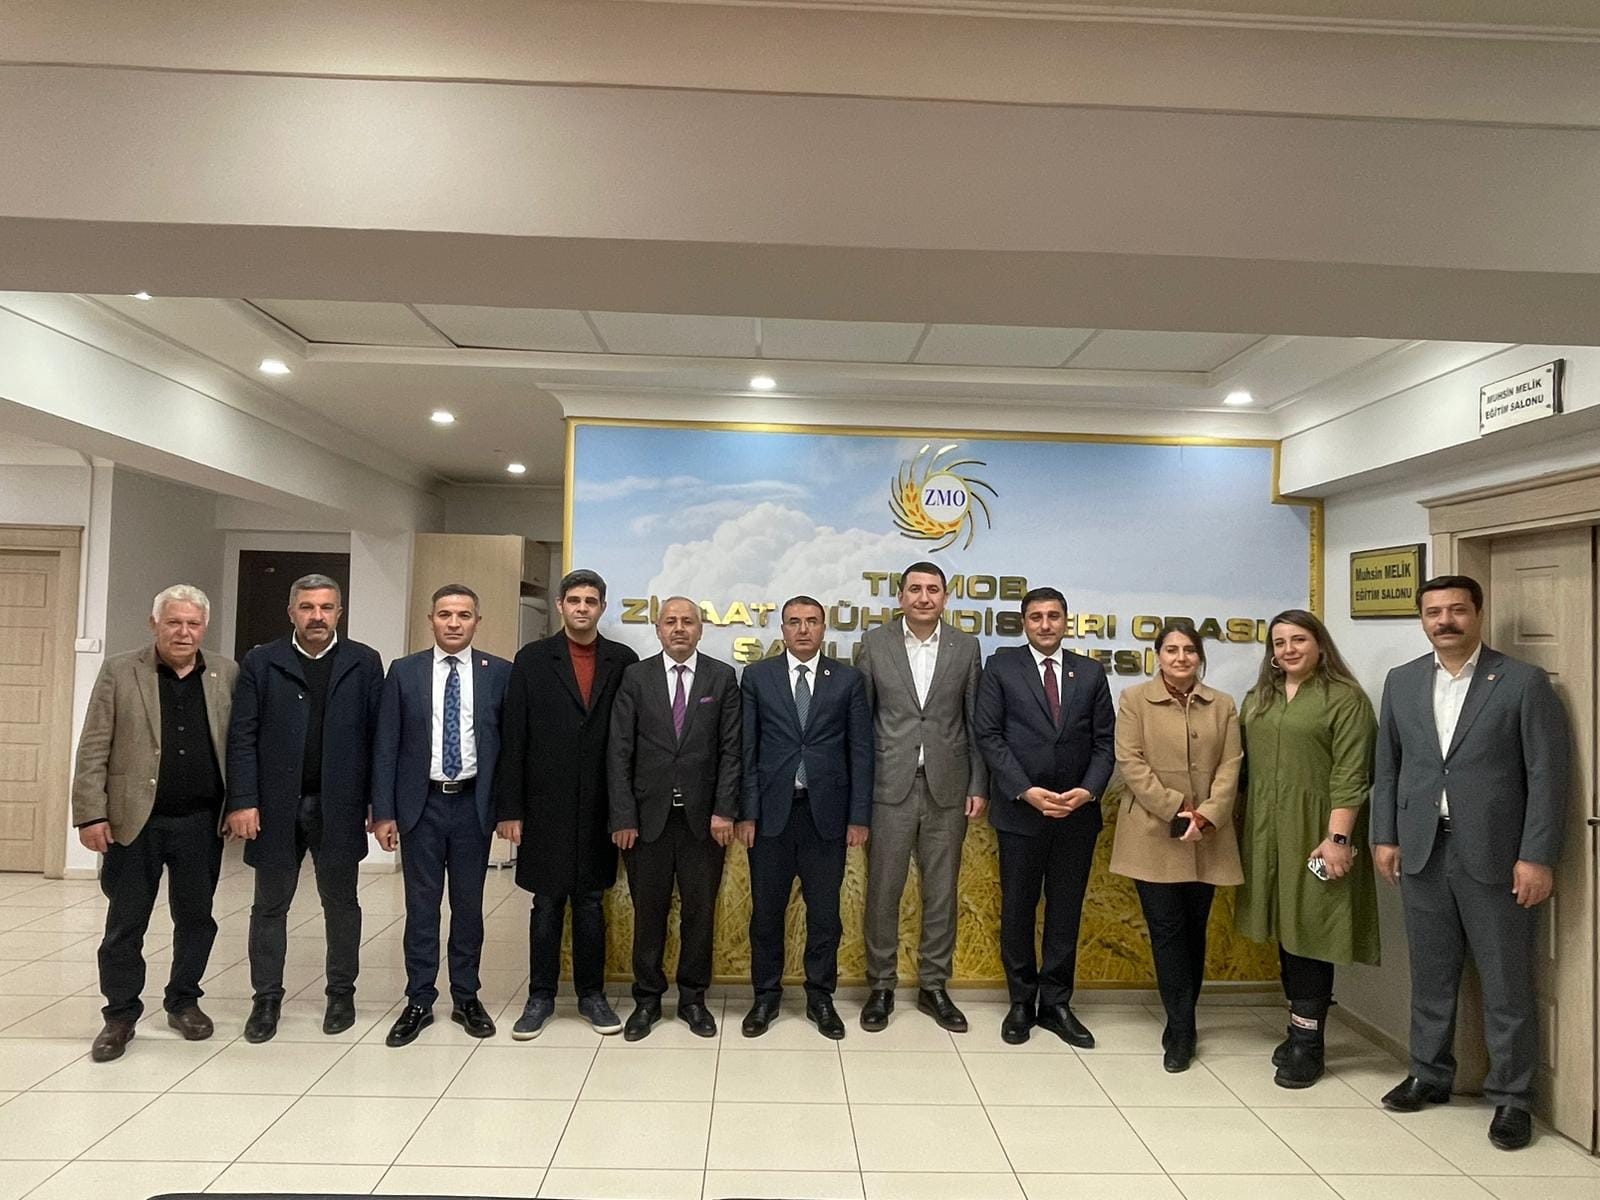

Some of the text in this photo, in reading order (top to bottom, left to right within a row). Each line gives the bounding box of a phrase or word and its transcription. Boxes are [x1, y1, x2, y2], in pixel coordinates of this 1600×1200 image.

[1487, 378, 1542, 404] MUHSİN MELİK
[1485, 394, 1544, 420] EĞİTİM SALONU
[925, 489, 966, 507] ZMO
[1355, 560, 1411, 581] Muhsin MELİK
[1355, 587, 1412, 601] EĞİTİM SALONU
[621, 595, 776, 628] ZİAAT
